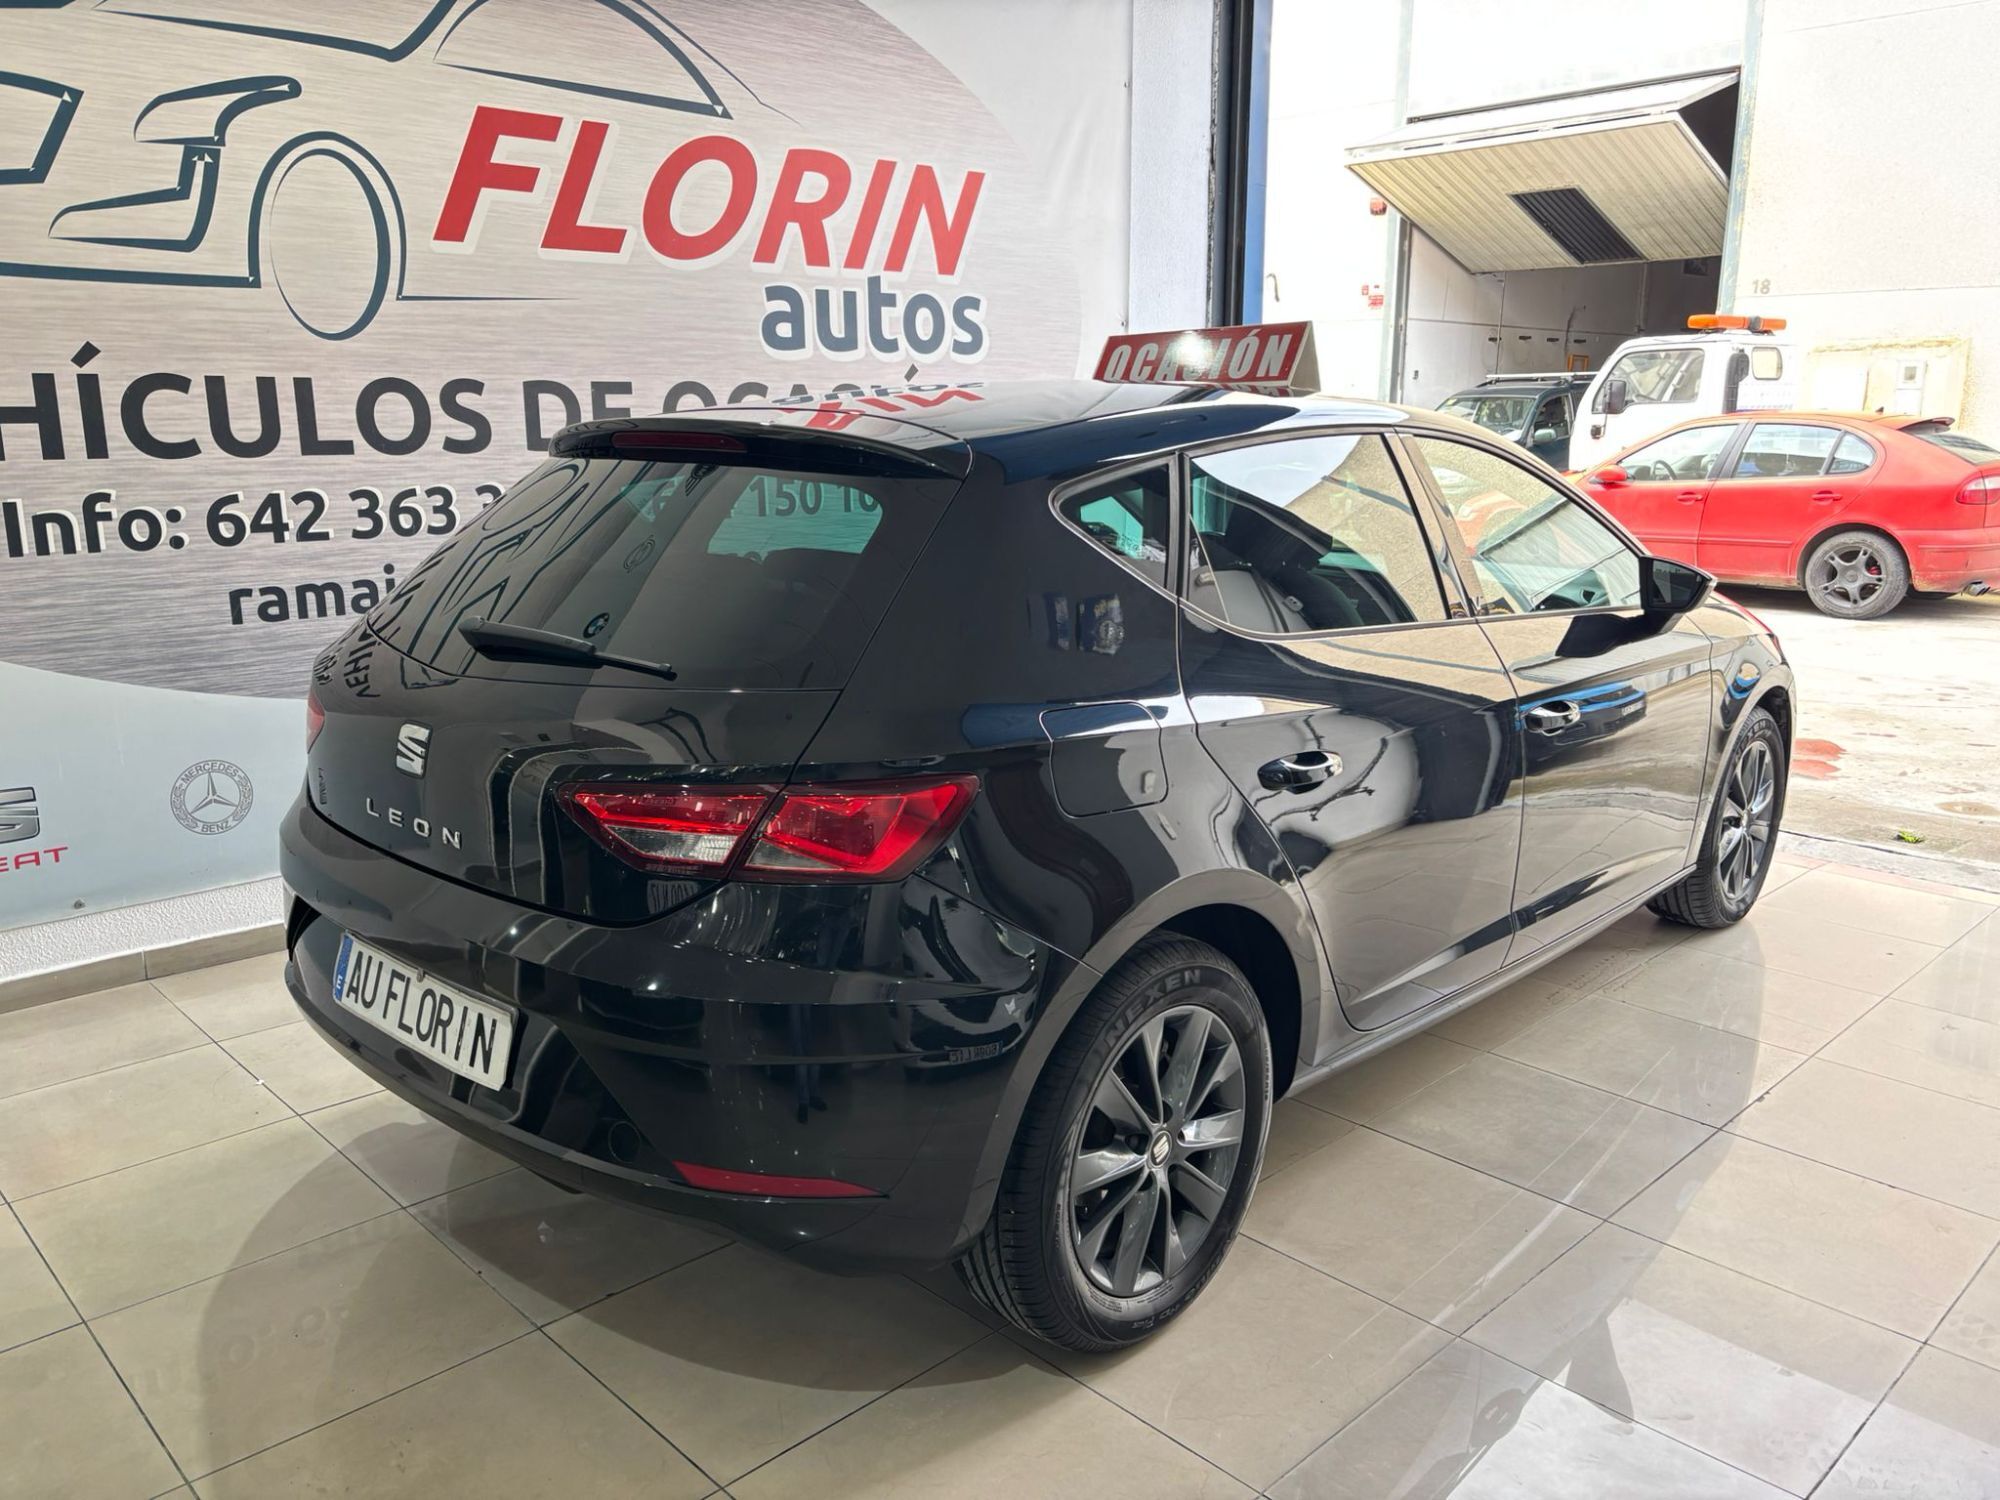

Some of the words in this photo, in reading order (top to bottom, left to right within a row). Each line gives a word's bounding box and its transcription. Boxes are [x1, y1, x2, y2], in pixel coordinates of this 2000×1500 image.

[431, 104, 987, 279] FLORIN
[760, 274, 985, 358] autos
[1752, 278, 1771, 295] 18
[522, 380, 633, 452] DE
[2, 490, 188, 557] Info:
[206, 489, 332, 546] 642
[349, 484, 460, 539] 363
[181, 762, 239, 785] MERCEDES
[200, 820, 232, 833] BENZ
[366, 797, 462, 850] LEON
[346, 950, 384, 1009] AU
[382, 968, 498, 1075] FLORIN
[1104, 968, 1201, 1049] NEXEN
